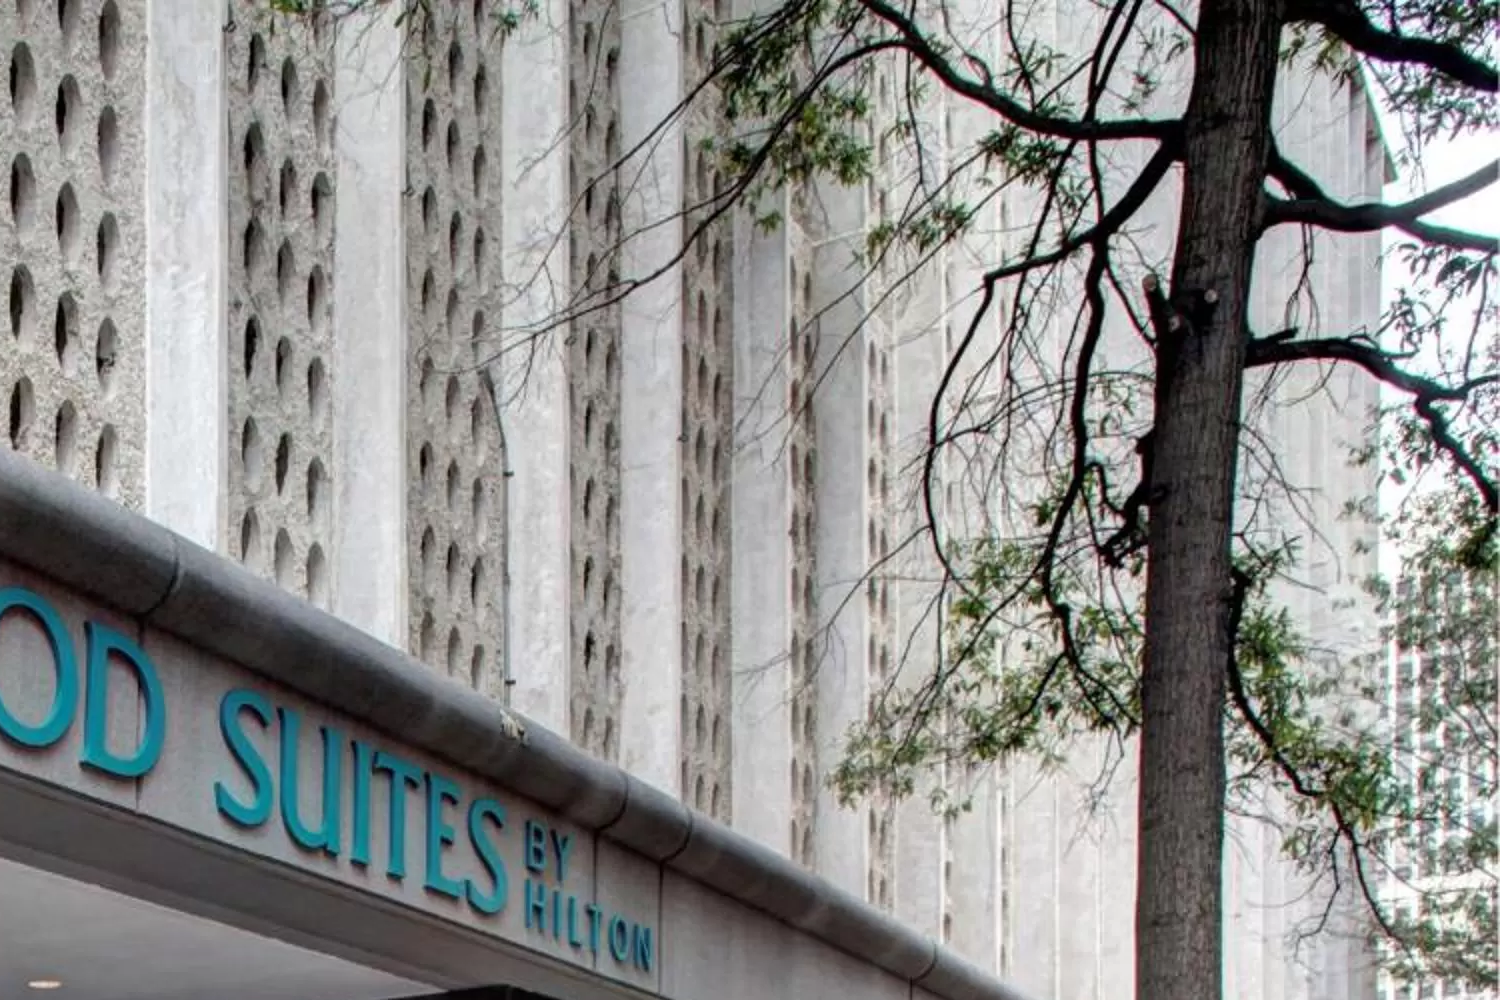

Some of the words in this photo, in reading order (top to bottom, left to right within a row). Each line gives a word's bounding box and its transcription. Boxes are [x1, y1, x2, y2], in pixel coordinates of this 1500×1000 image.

[214, 688, 508, 915] SUITES
[524, 819, 575, 882] BY
[524, 878, 653, 972] HILTON
